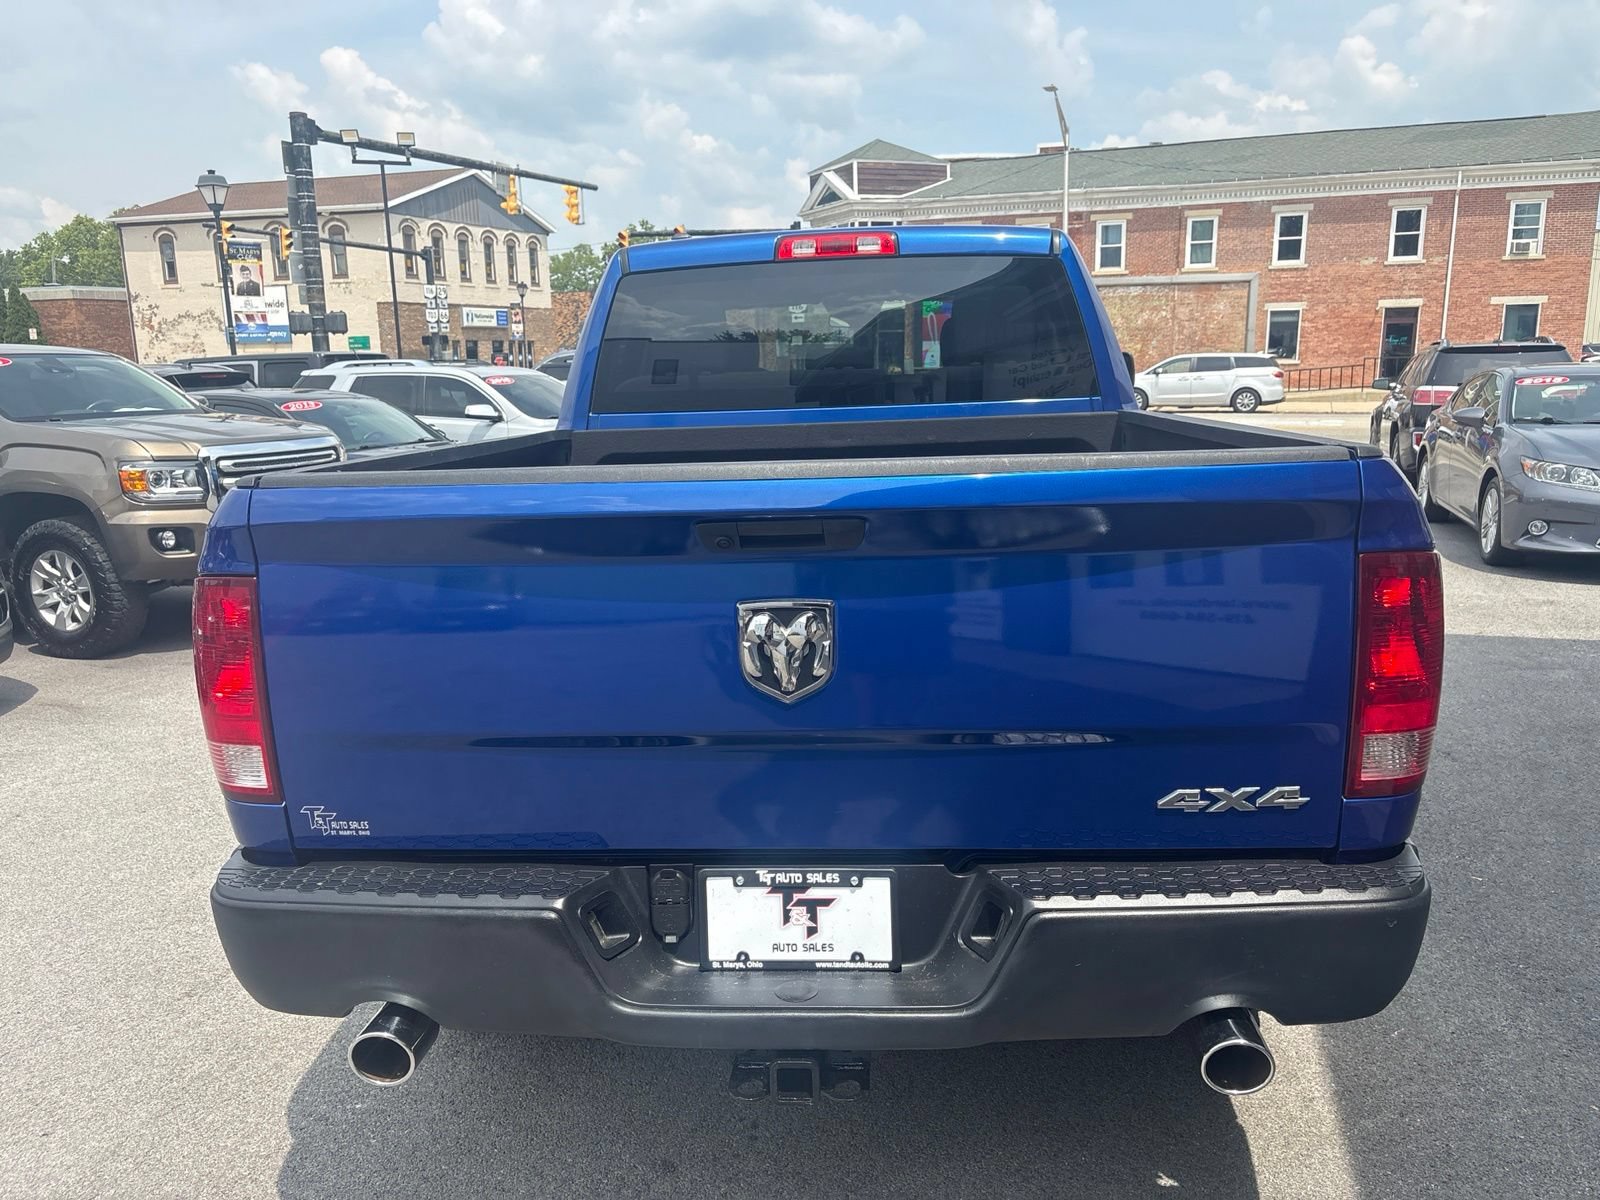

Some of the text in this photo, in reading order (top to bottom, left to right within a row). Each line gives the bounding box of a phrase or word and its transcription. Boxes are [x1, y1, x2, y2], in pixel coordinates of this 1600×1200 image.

[438, 286, 447, 295] 29
[440, 311, 448, 319] 66
[331, 821, 348, 829] AUTO
[349, 821, 369, 829] SALES
[776, 872, 803, 884] AUTO
[806, 872, 840, 884] SALES
[772, 943, 834, 953] AUTO SALES
